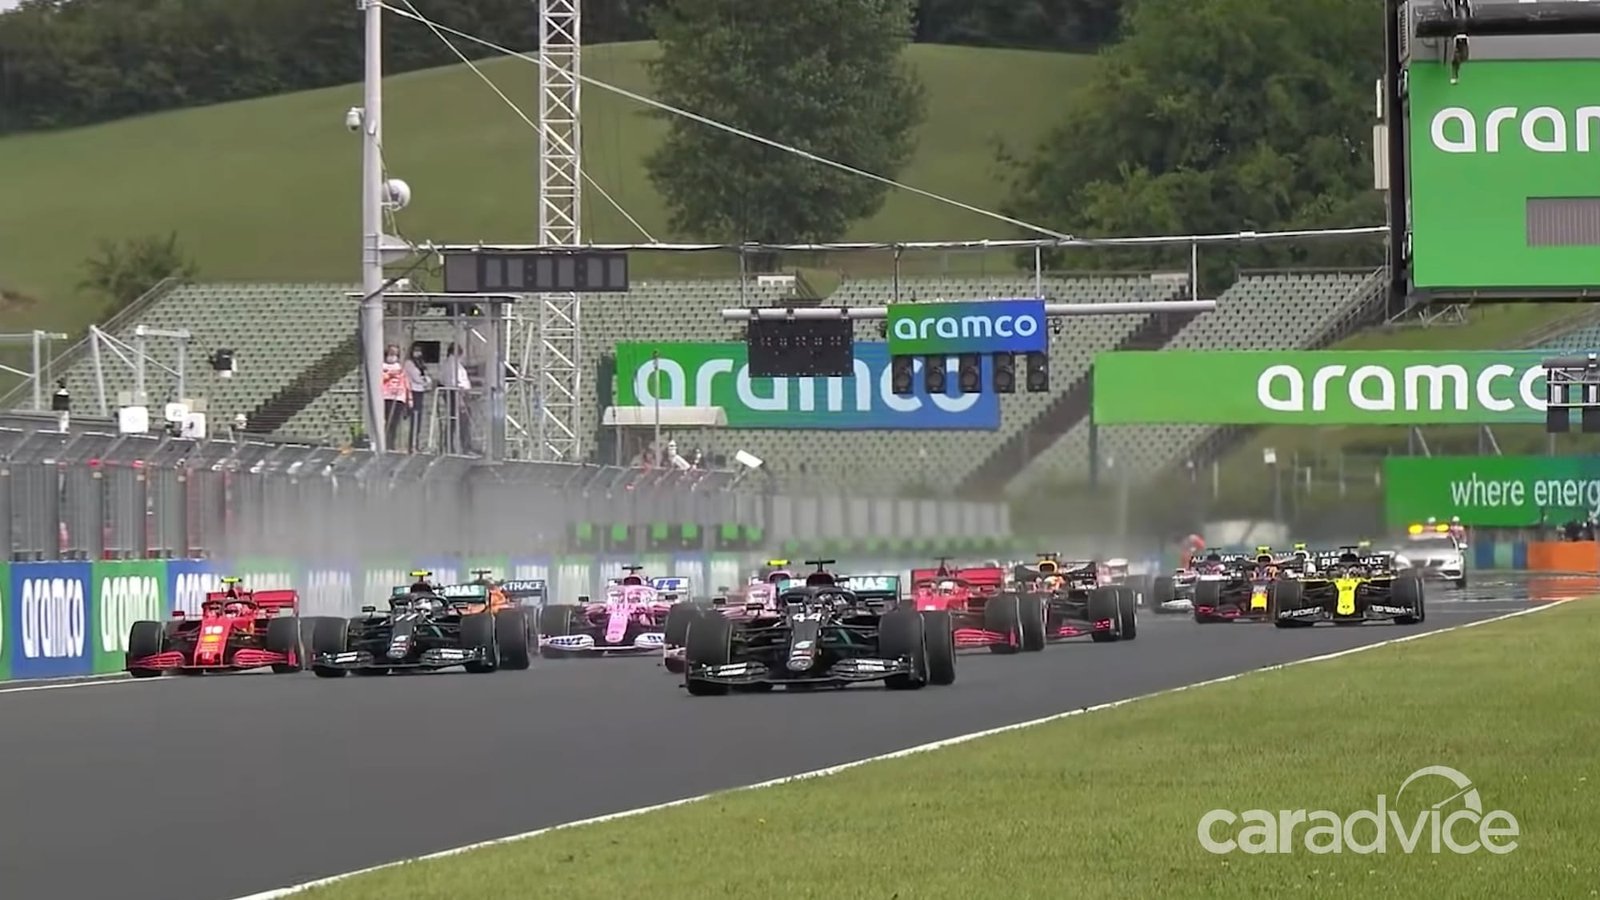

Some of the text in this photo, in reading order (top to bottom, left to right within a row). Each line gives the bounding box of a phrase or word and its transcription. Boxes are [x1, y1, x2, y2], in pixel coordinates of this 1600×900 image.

[894, 314, 1038, 340] aramco
[1451, 472, 1525, 506] where
[22, 577, 85, 658] aramco
[792, 612, 822, 622] 44
